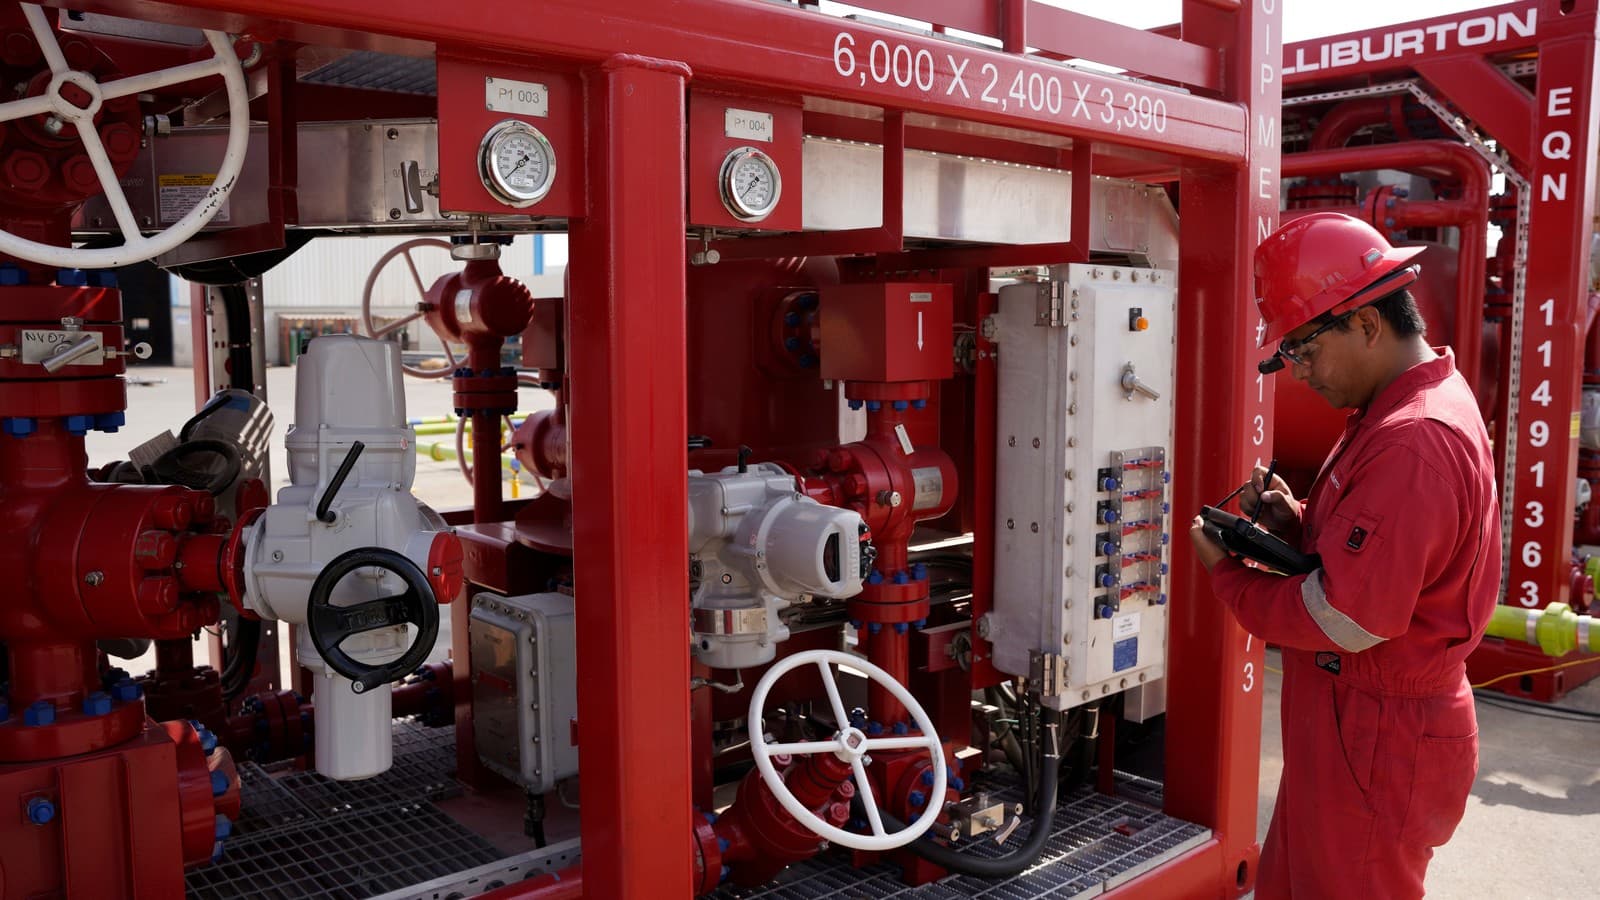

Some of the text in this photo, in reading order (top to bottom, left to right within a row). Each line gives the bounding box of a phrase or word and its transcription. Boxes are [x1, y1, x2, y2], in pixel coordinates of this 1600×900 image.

[518, 90, 540, 104] 003
[833, 32, 1167, 134] 6,000 X 2,400 X 3,390
[749, 120, 766, 132] 004
[1519, 86, 1573, 607] EQN 11491363
